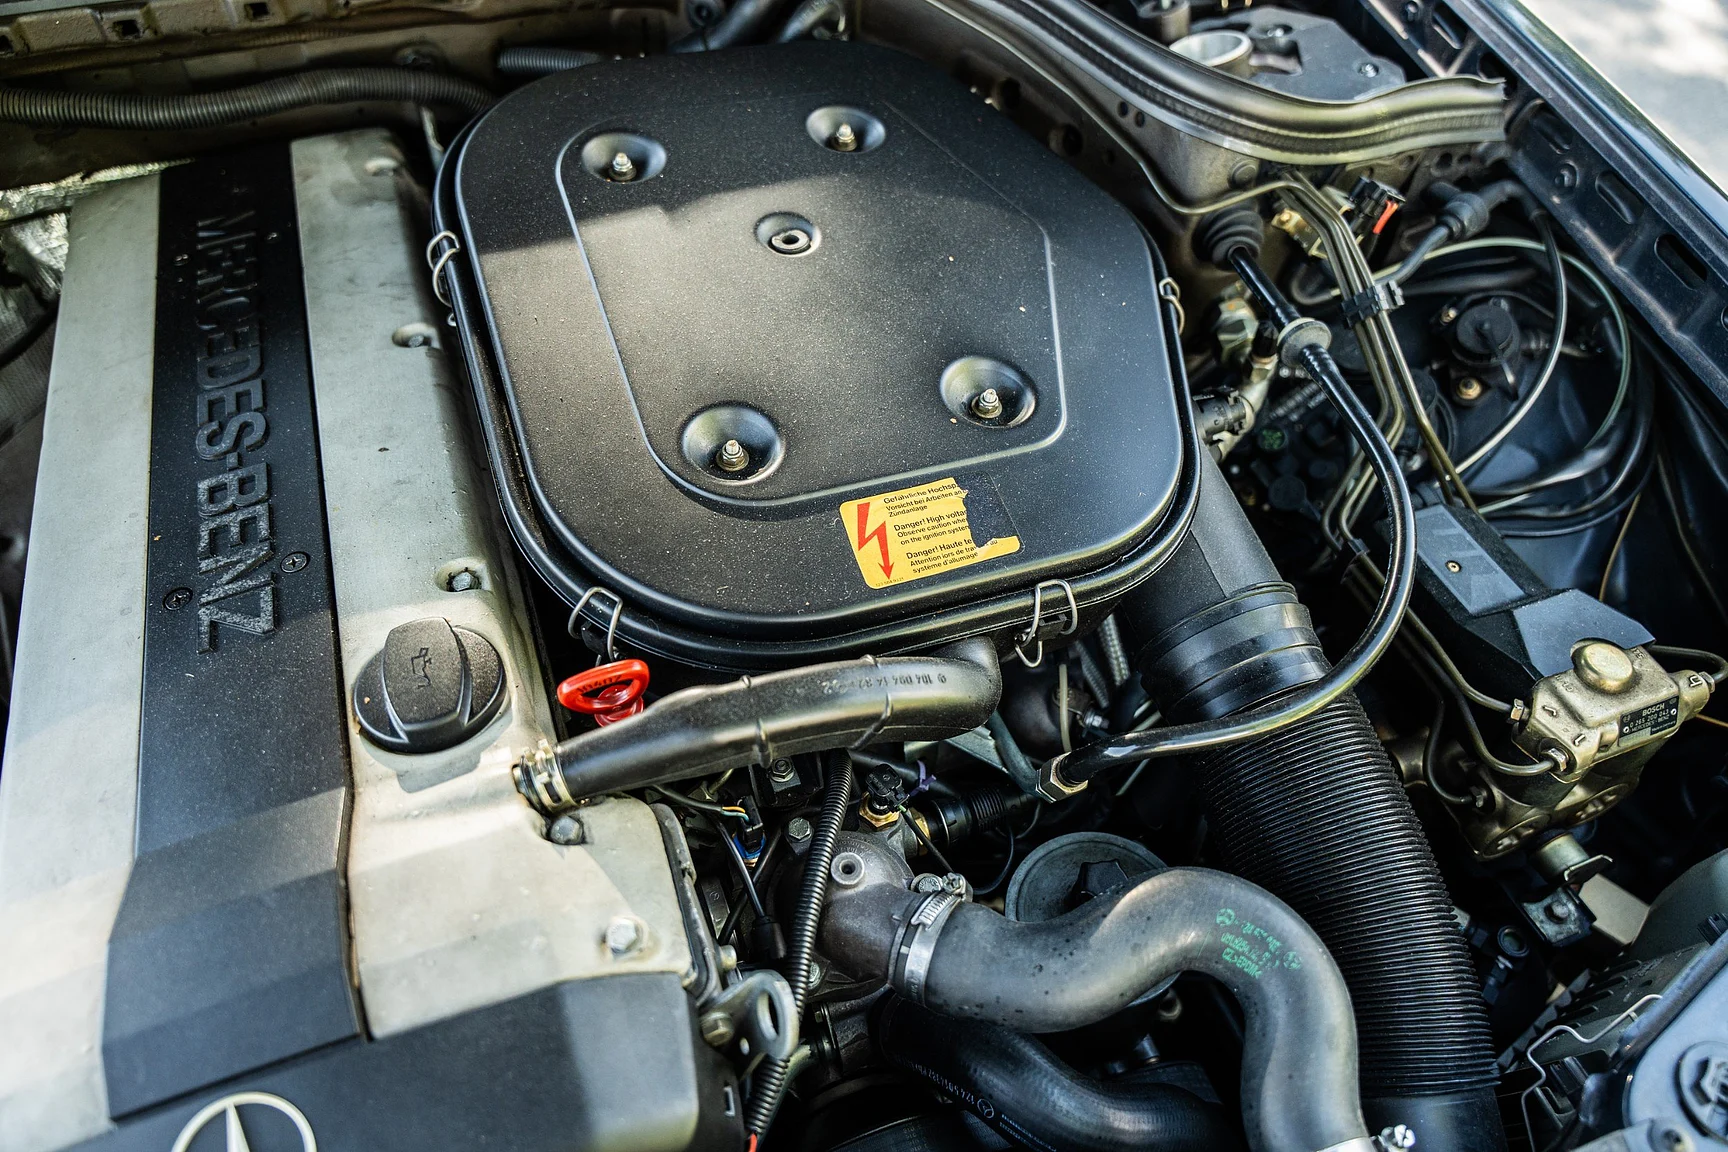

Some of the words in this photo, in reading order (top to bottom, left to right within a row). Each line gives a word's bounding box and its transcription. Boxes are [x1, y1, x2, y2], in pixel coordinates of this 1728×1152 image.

[196, 209, 279, 656] MERCEDES-BENZ
[928, 483, 957, 493] Hochsp
[886, 501, 914, 511] Vorsicht
[926, 491, 953, 502] Arbeiten
[889, 505, 928, 518] Zündanlage
[893, 519, 926, 532] Danger!
[926, 514, 945, 524] High
[897, 527, 926, 538] Observe
[927, 522, 952, 531] caution
[922, 530, 947, 541] ignition
[906, 546, 938, 559] Danger!
[939, 541, 963, 551] Haute
[910, 555, 942, 567] Attention
[942, 551, 955, 559] lors
[955, 548, 965, 556] de
[943, 552, 979, 565] d'allumage
[1642, 702, 1665, 716] BOSCH
